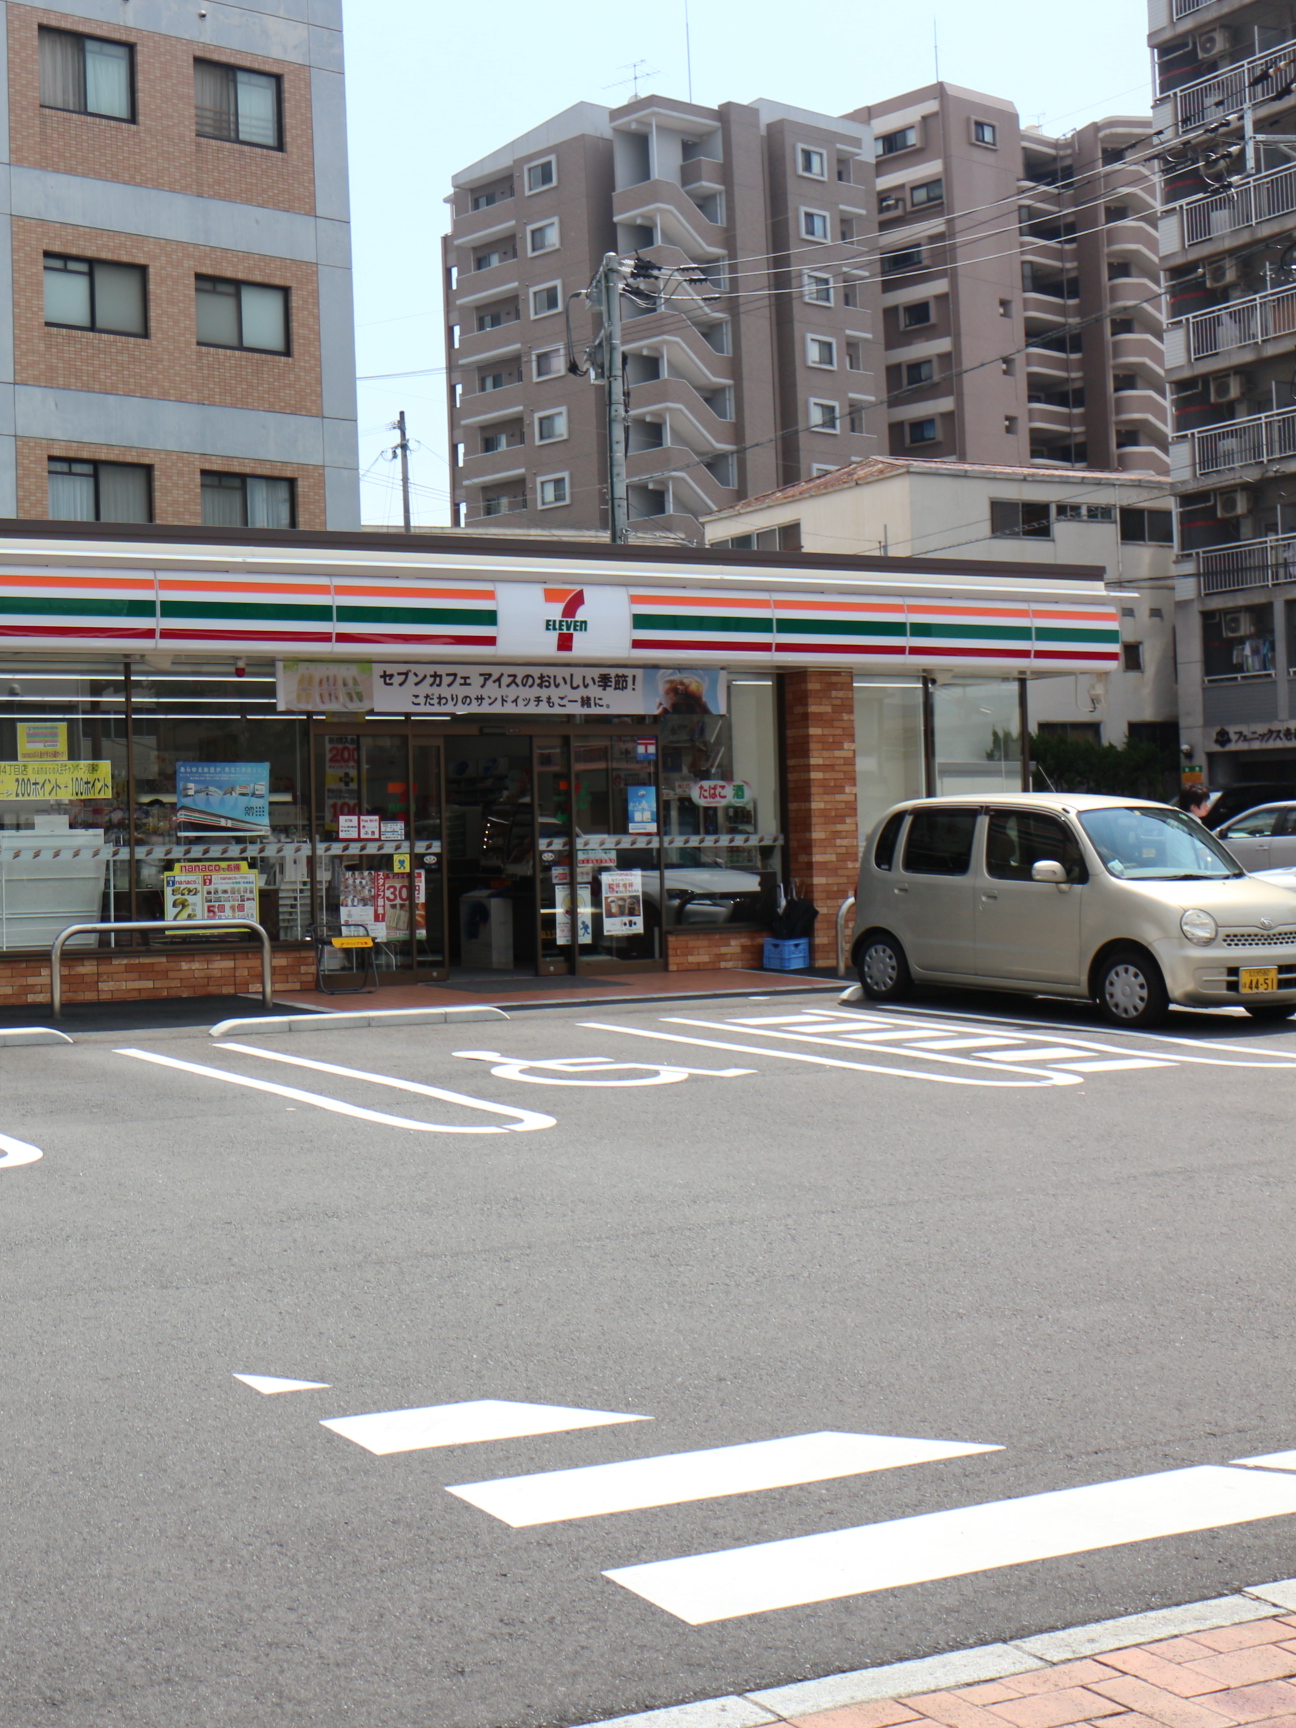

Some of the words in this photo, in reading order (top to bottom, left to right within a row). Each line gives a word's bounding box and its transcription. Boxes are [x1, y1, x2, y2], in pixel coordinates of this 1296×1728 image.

[544, 588, 585, 651] 7
[379, 670, 472, 687] セブンカフェ
[478, 673, 636, 692] アイスのおいしい季節!
[411, 693, 612, 709] こだわりのサンドイッチもご一緒に。
[698, 784, 727, 799] たばこ
[733, 785, 745, 799] 酒
[1248, 978, 1274, 991] 44-51
